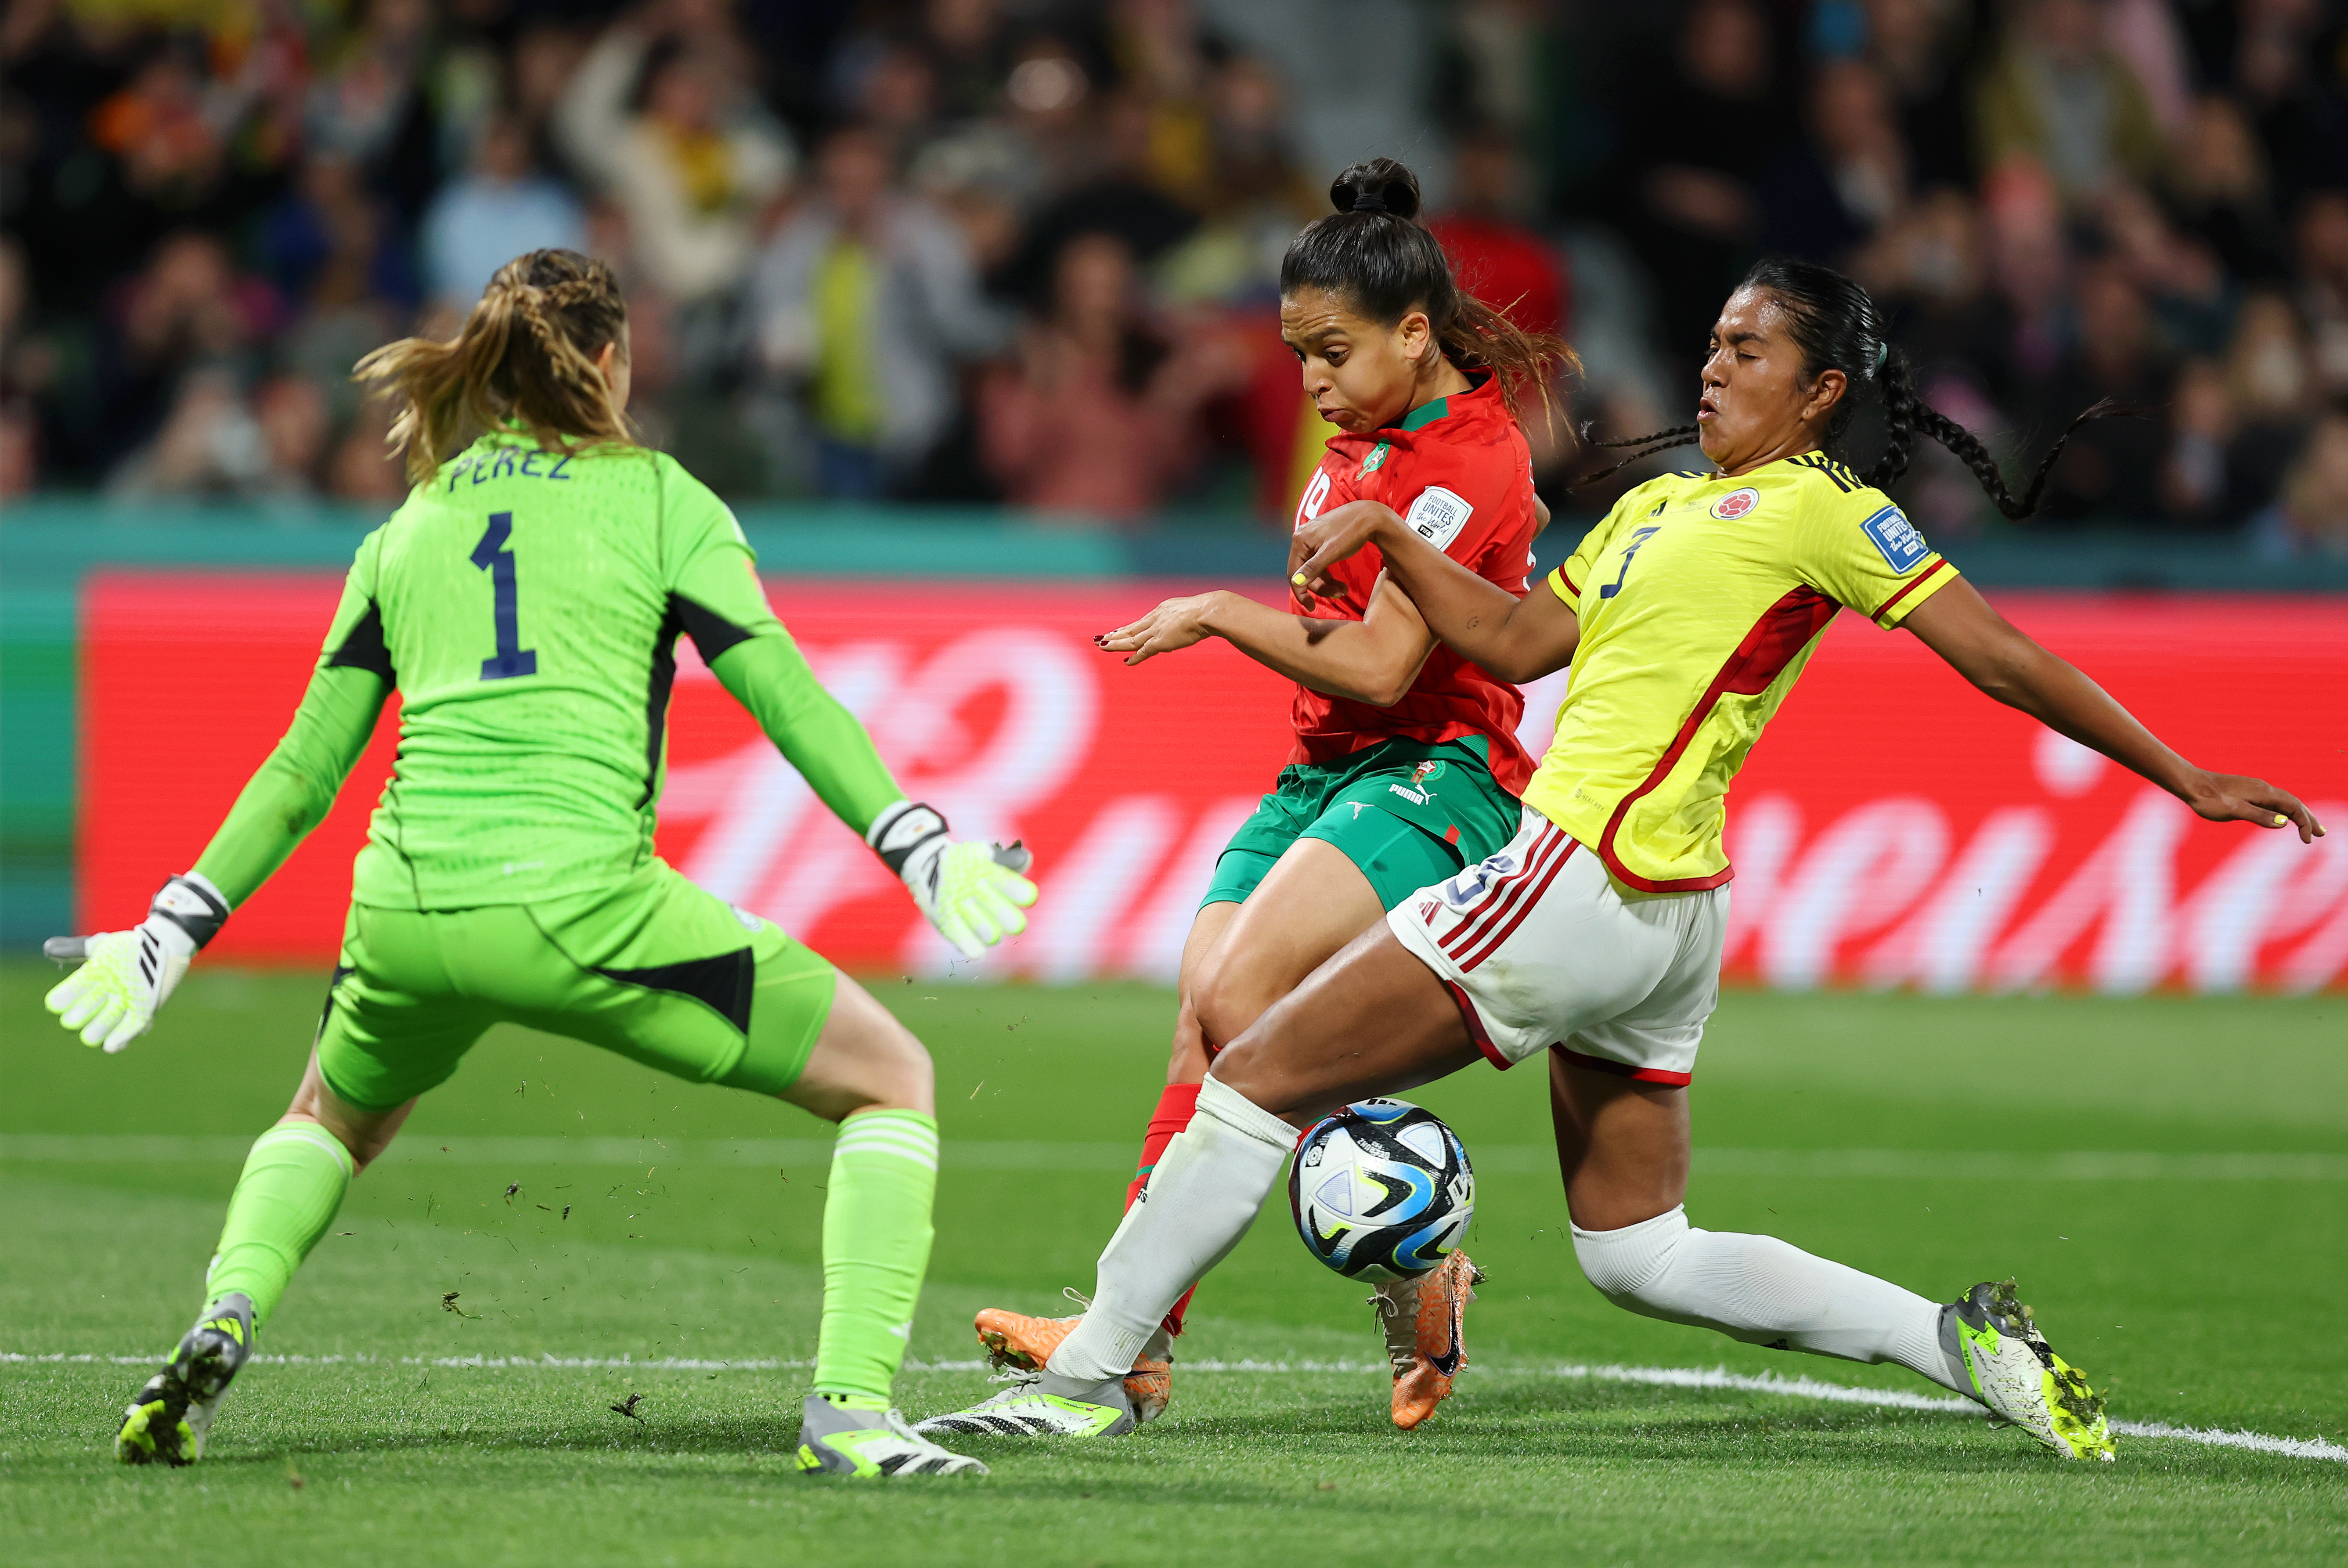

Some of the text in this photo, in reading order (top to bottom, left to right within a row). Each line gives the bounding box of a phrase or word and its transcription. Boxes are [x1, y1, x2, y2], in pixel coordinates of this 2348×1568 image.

[449, 445, 574, 492] PEREZ
[1422, 502, 1454, 526] UNITES
[1428, 495, 1457, 517] FOOTBALL
[1416, 512, 1450, 535] the World
[1420, 526, 1432, 537] FIFA
[1876, 513, 1902, 533] FOOTBALL
[1882, 520, 1908, 542] UNITES
[1889, 540, 1903, 552] the
[470, 512, 537, 681] 1
[1388, 783, 1425, 805] PUMA
